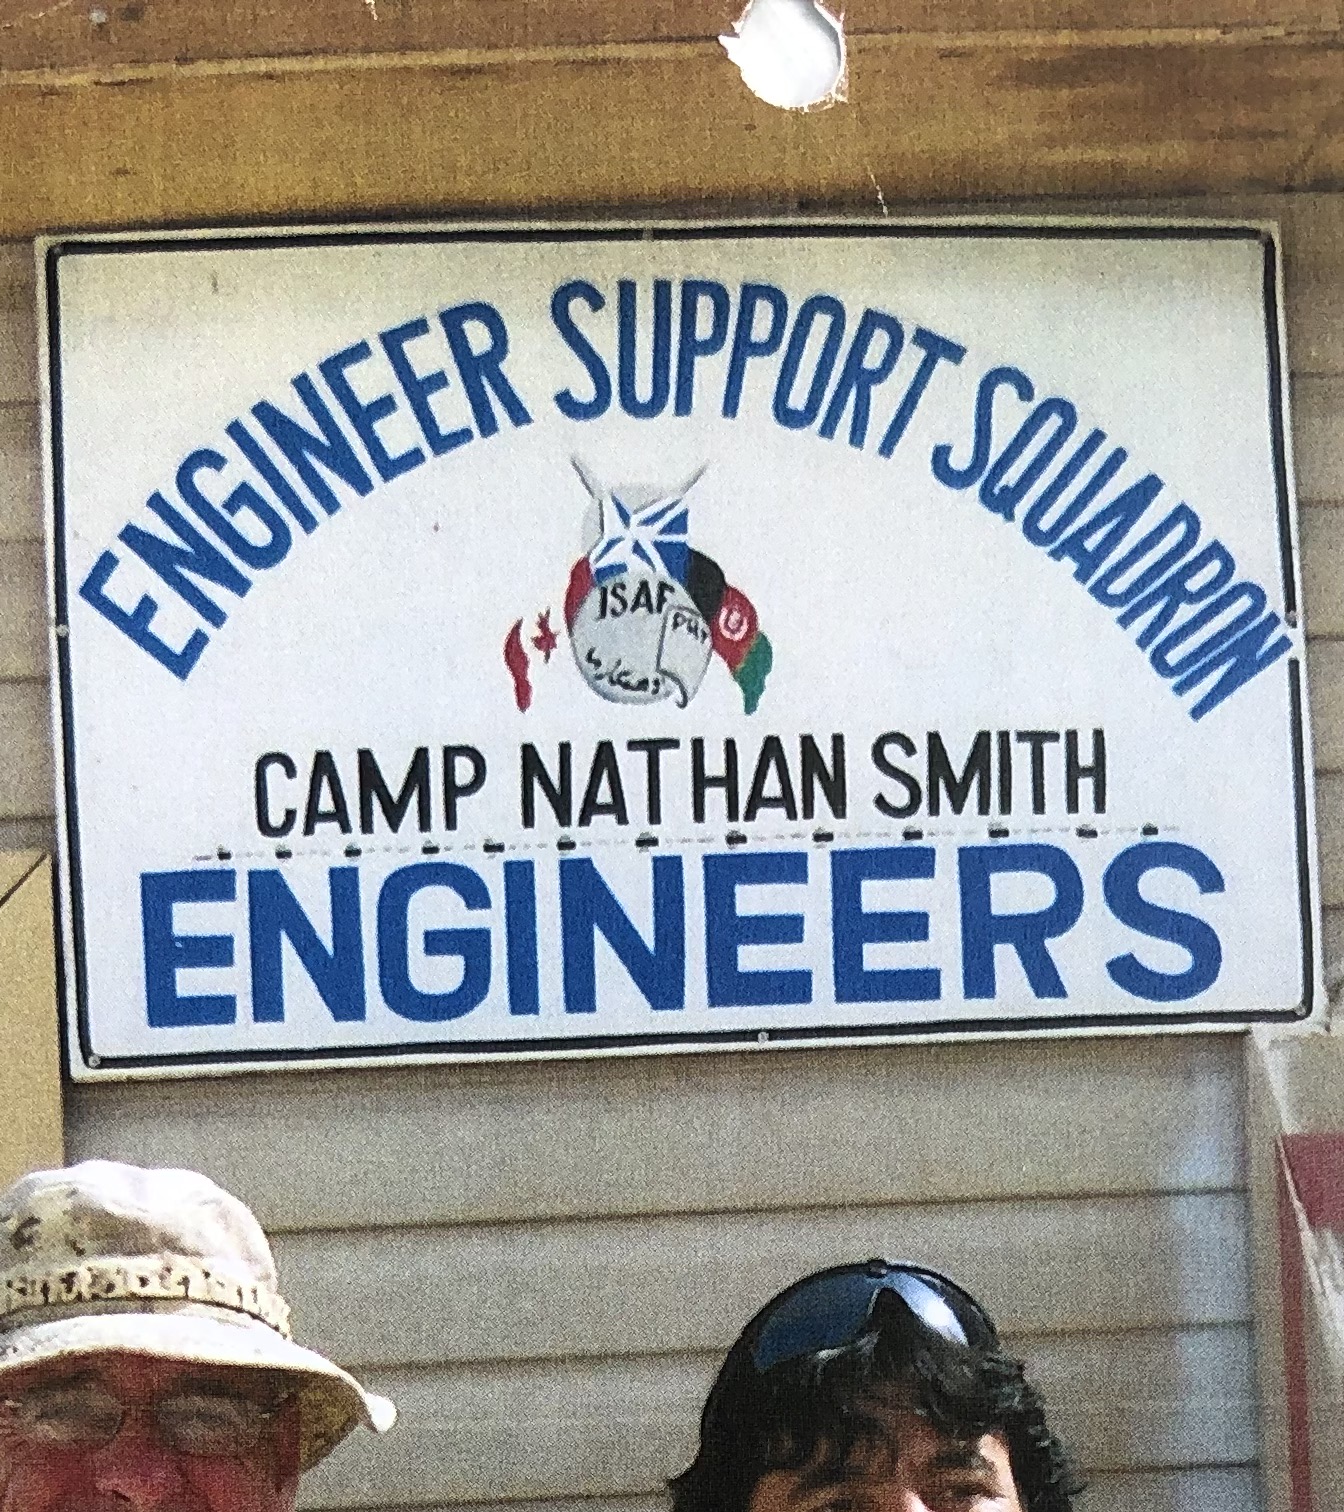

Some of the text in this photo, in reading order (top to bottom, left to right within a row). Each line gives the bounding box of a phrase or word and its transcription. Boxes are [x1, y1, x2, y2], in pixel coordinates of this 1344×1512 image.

[78, 277, 1293, 722] ENGINEER SUPPORT SQUADRON
[597, 579, 675, 620] ISAF
[255, 727, 1107, 838] CAMP NATHAN SMITH
[140, 841, 1226, 1029] ENGINEERS
